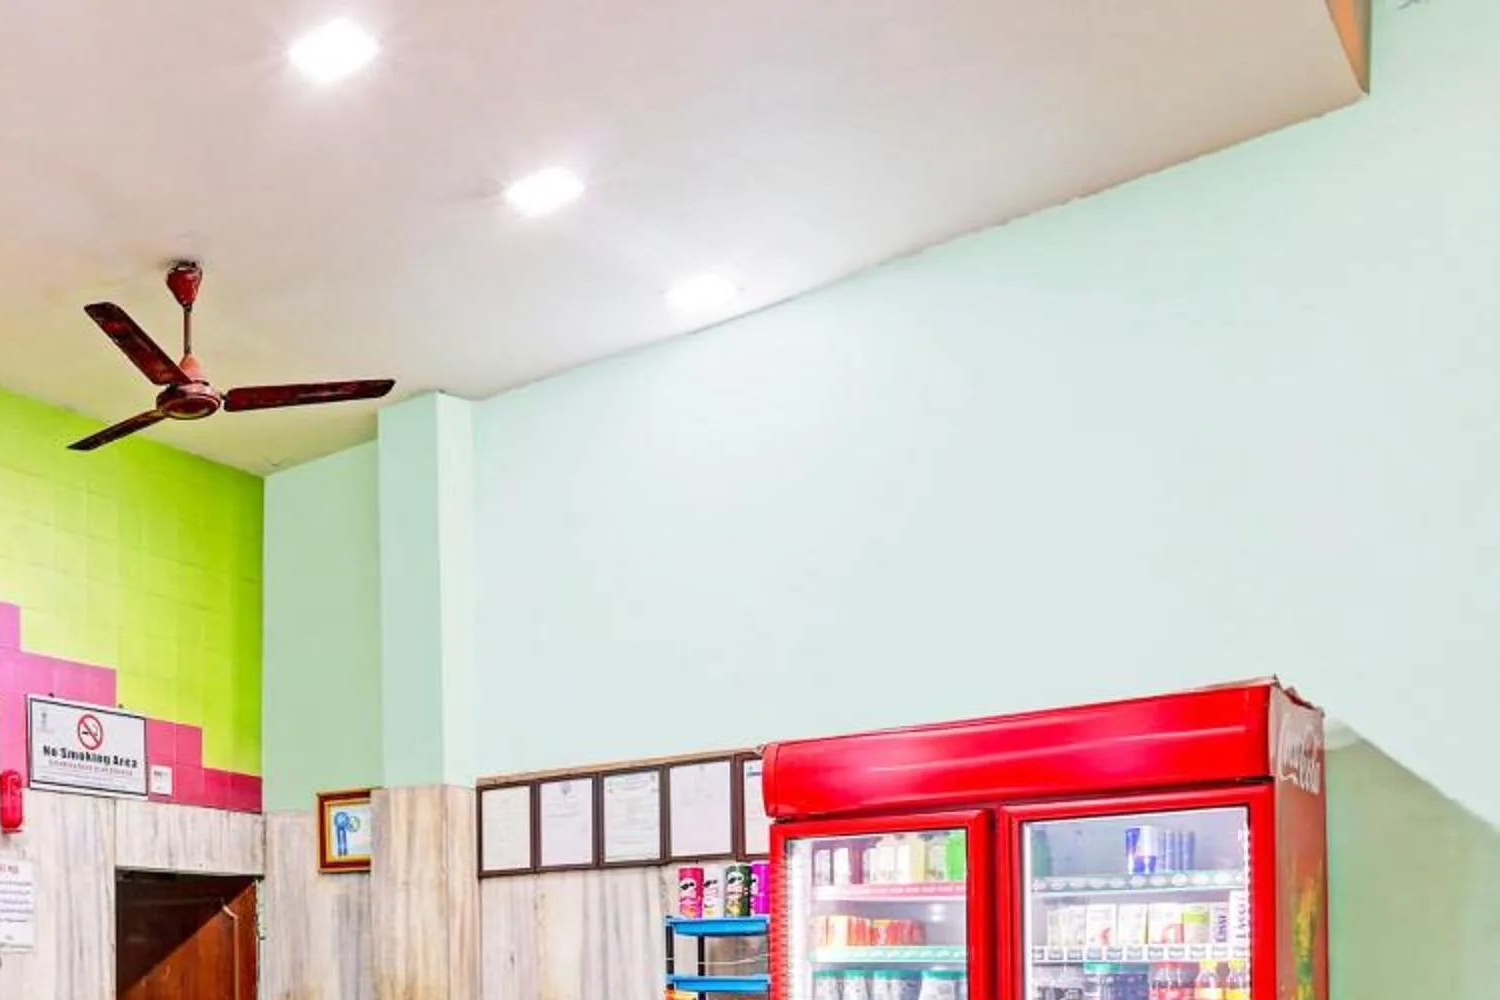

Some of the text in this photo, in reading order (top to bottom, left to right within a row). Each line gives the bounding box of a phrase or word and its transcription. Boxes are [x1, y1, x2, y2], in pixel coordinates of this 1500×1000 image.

[42, 744, 58, 758] No
[60, 747, 111, 766] Smoking
[113, 755, 138, 769] Area
